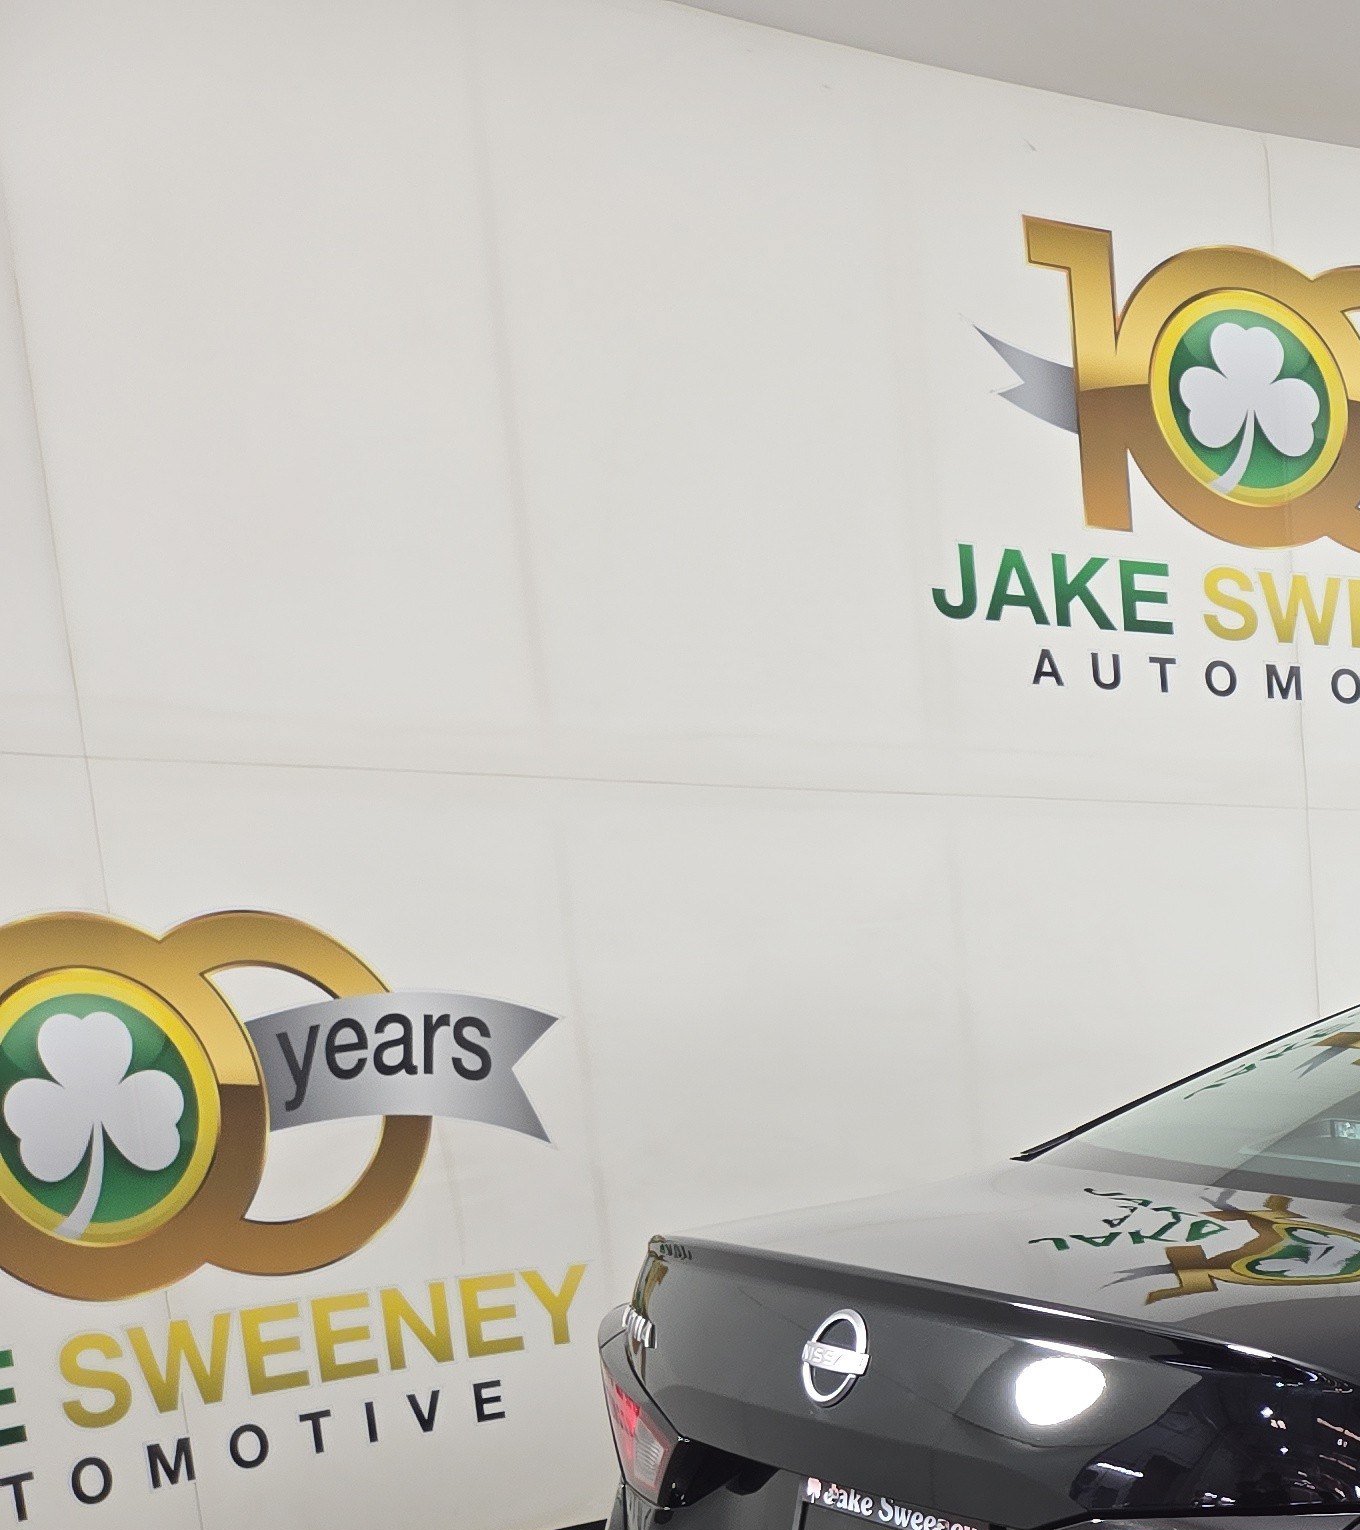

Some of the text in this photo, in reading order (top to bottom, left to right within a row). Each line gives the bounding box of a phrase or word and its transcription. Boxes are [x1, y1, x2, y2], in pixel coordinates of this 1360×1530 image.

[931, 541, 1175, 636] JAKE
[275, 1011, 493, 1113] years
[57, 1264, 588, 1429] SWEENEY
[823, 1485, 874, 1517] Jake
